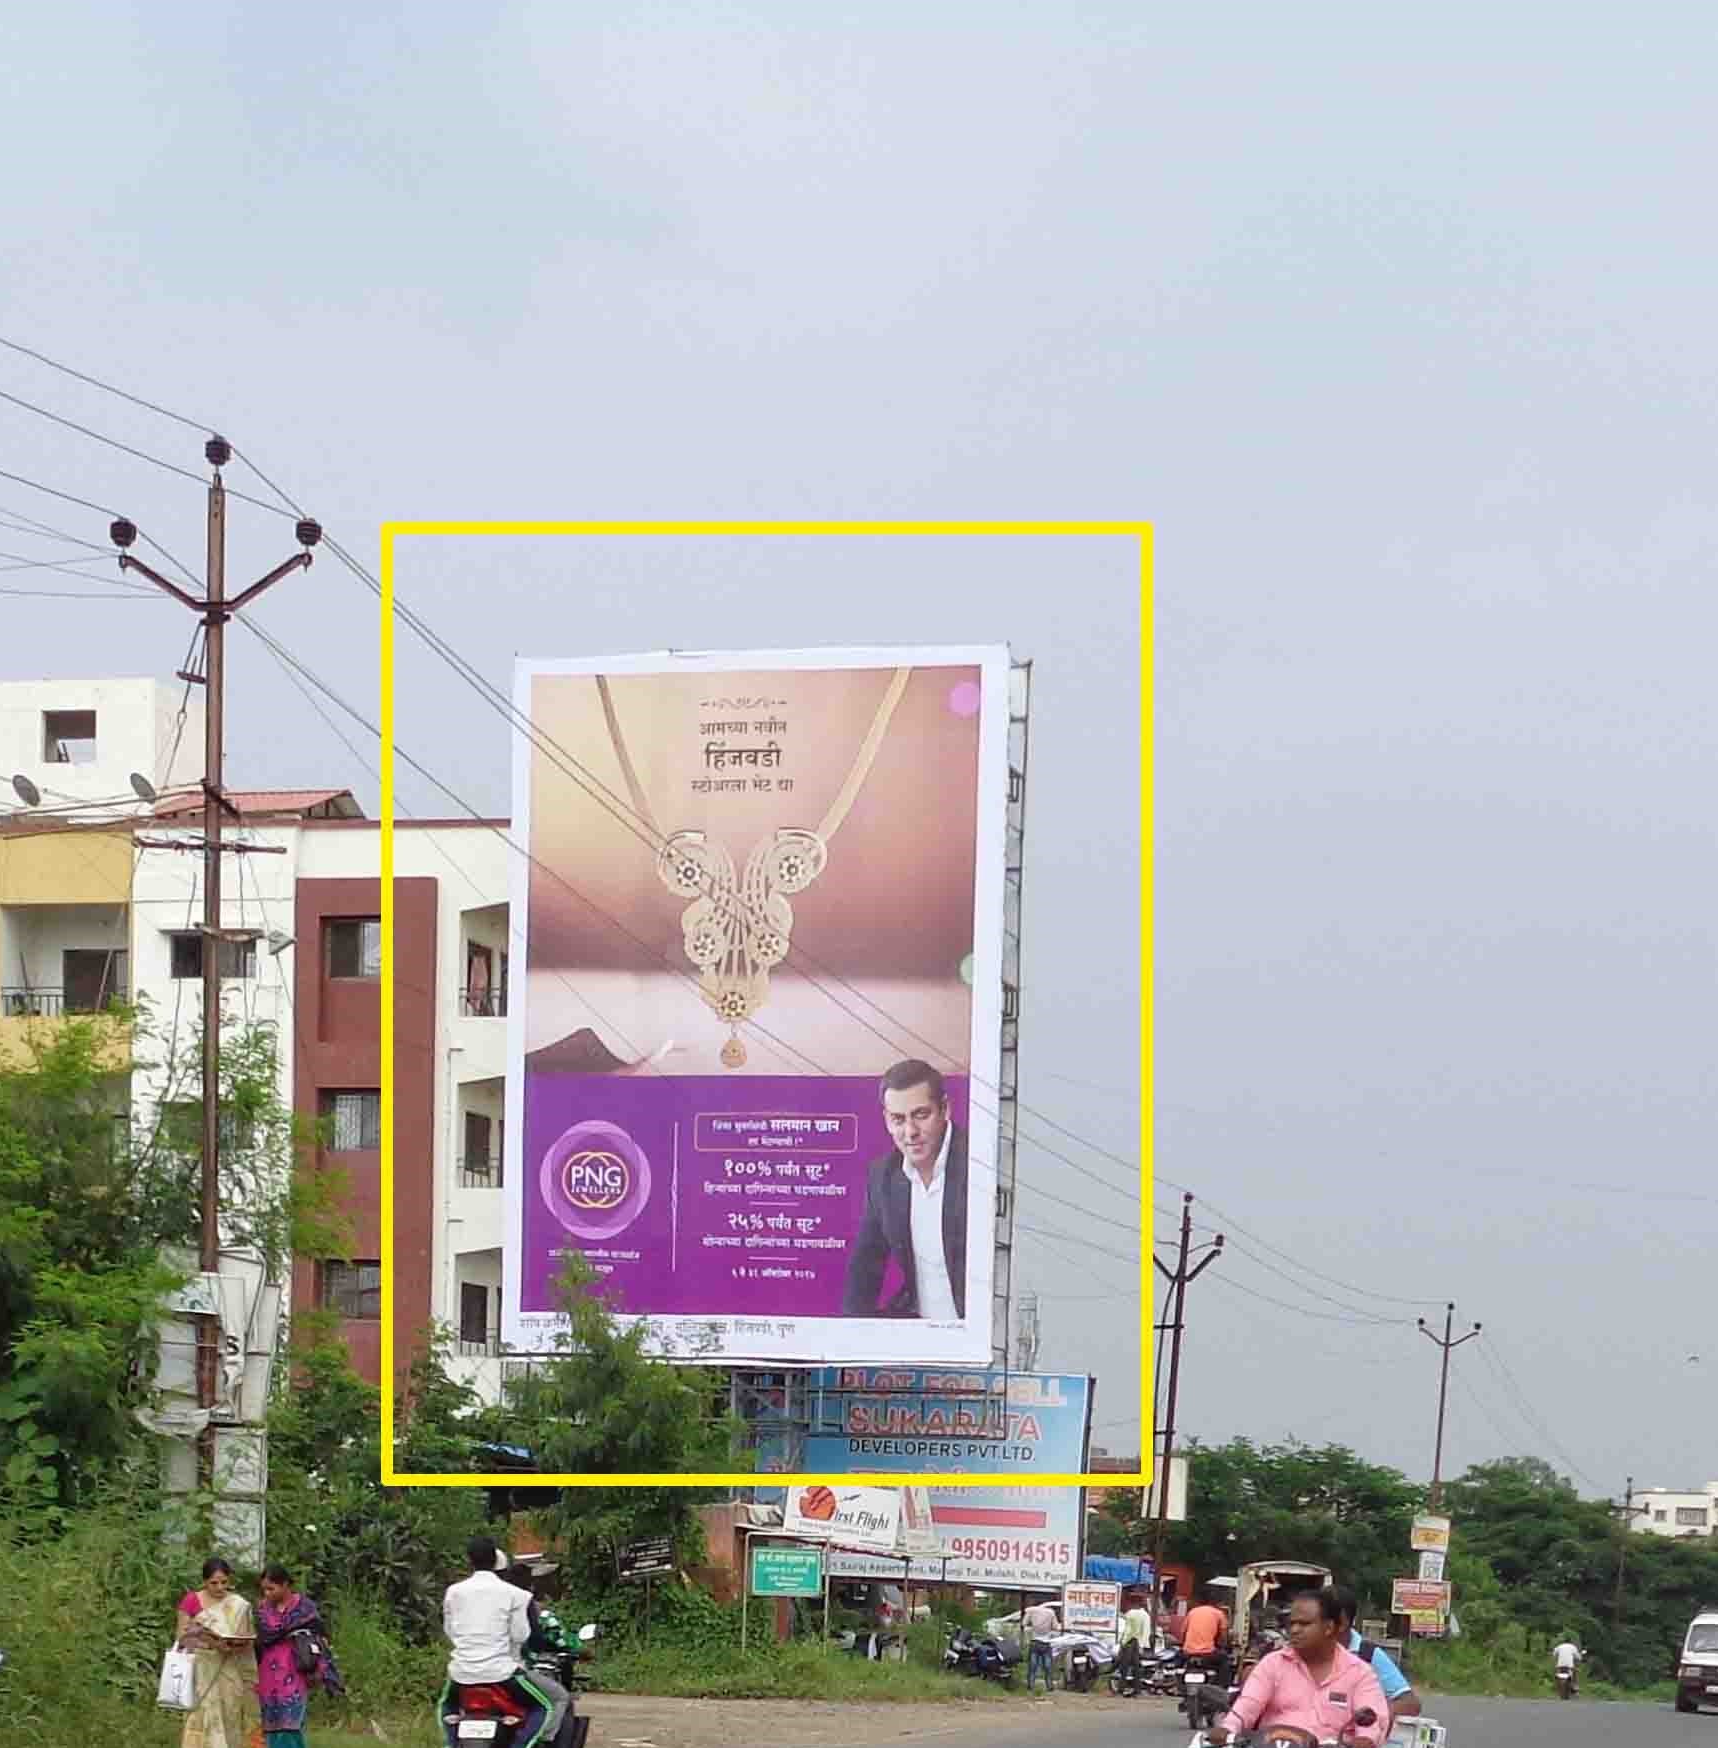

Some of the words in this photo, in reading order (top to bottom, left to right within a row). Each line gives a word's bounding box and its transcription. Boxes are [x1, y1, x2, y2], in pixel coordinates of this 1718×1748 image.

[704, 740, 784, 771] हिंजवडी
[570, 1165, 622, 1187] PNG
[849, 1438, 963, 1459] DEVELOPERS
[857, 1511, 891, 1531] Flight
[950, 1538, 1071, 1566] 9850914515
